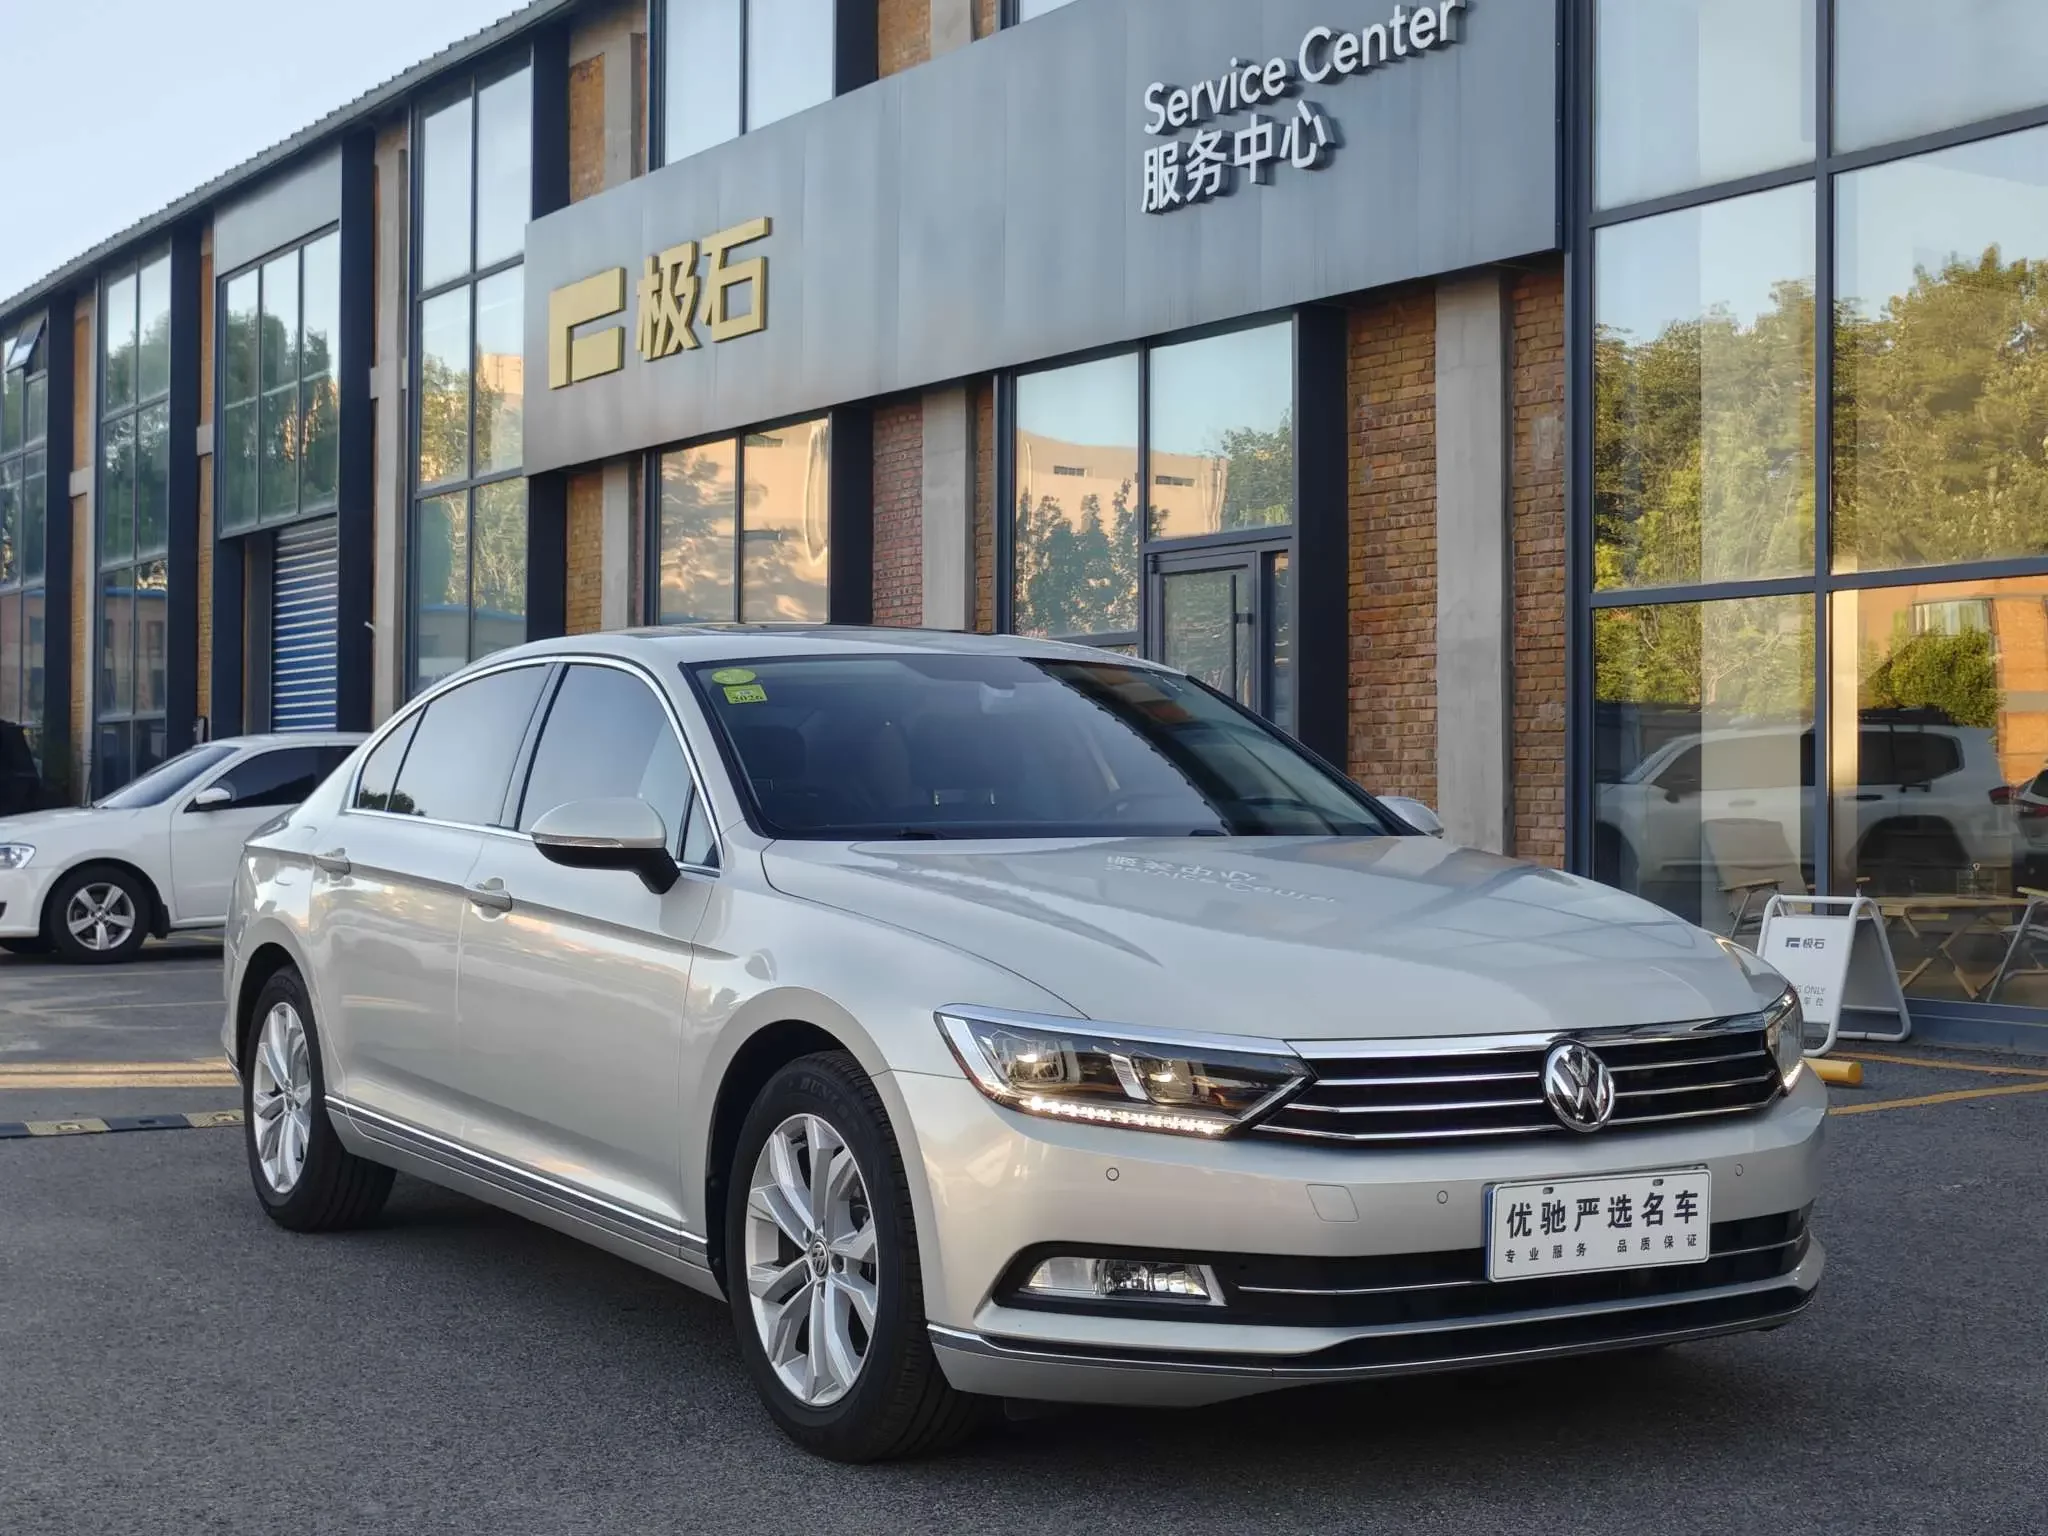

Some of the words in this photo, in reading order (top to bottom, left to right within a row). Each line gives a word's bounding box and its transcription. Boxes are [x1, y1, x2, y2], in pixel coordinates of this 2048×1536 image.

[1144, 57, 1288, 134] Service
[1299, 0, 1466, 84] Center
[1141, 100, 1330, 213] 服务中心
[636, 216, 770, 362] 极石
[1505, 1242, 1587, 1264] 专业服务
[1617, 1233, 1697, 1253] 品质保证
[1506, 1190, 1698, 1239] 优驰严选名车
